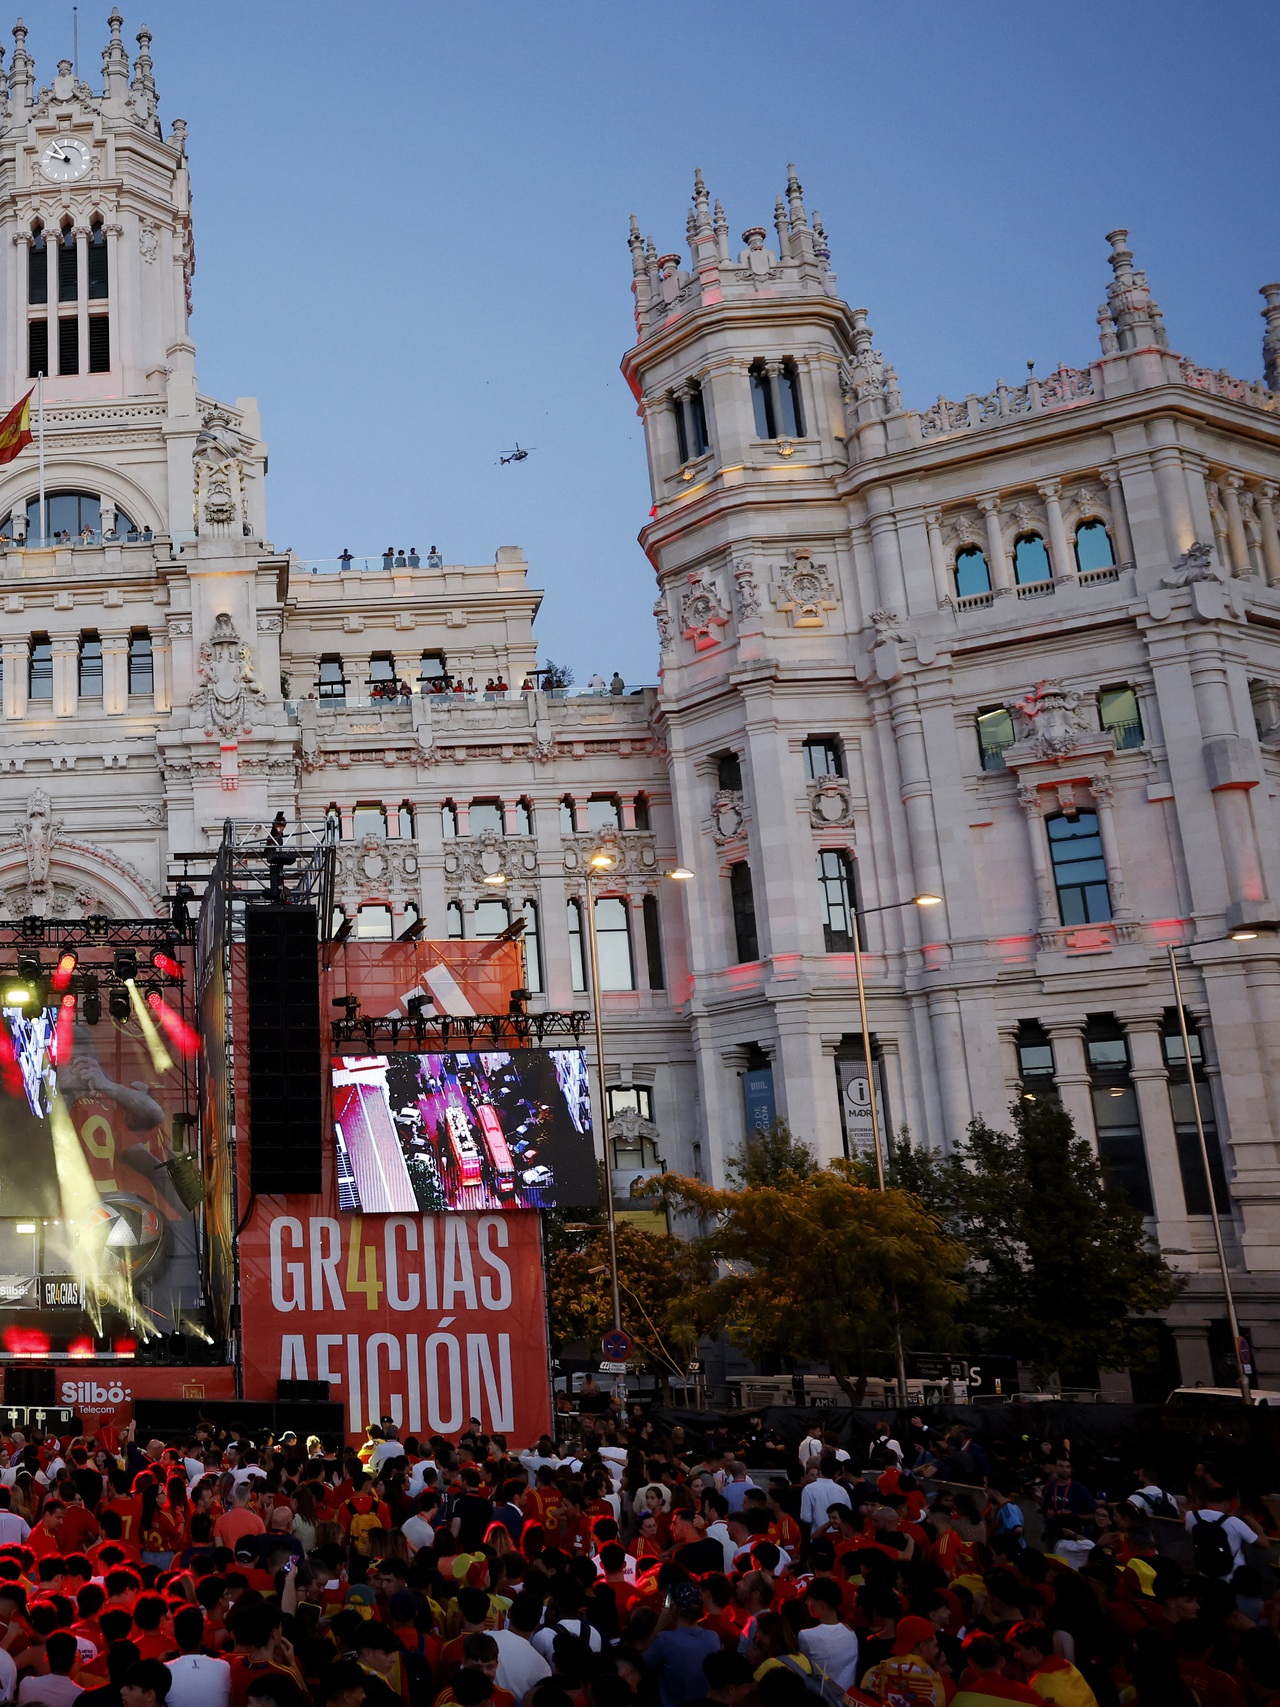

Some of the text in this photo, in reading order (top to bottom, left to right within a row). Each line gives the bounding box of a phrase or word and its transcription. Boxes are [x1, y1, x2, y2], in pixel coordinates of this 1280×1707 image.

[848, 1109, 880, 1118] MADR
[269, 1215, 512, 1312] GR4CIAS
[45, 1283, 78, 1305] GR4CIAS
[79, 1405, 115, 1414] Telecom
